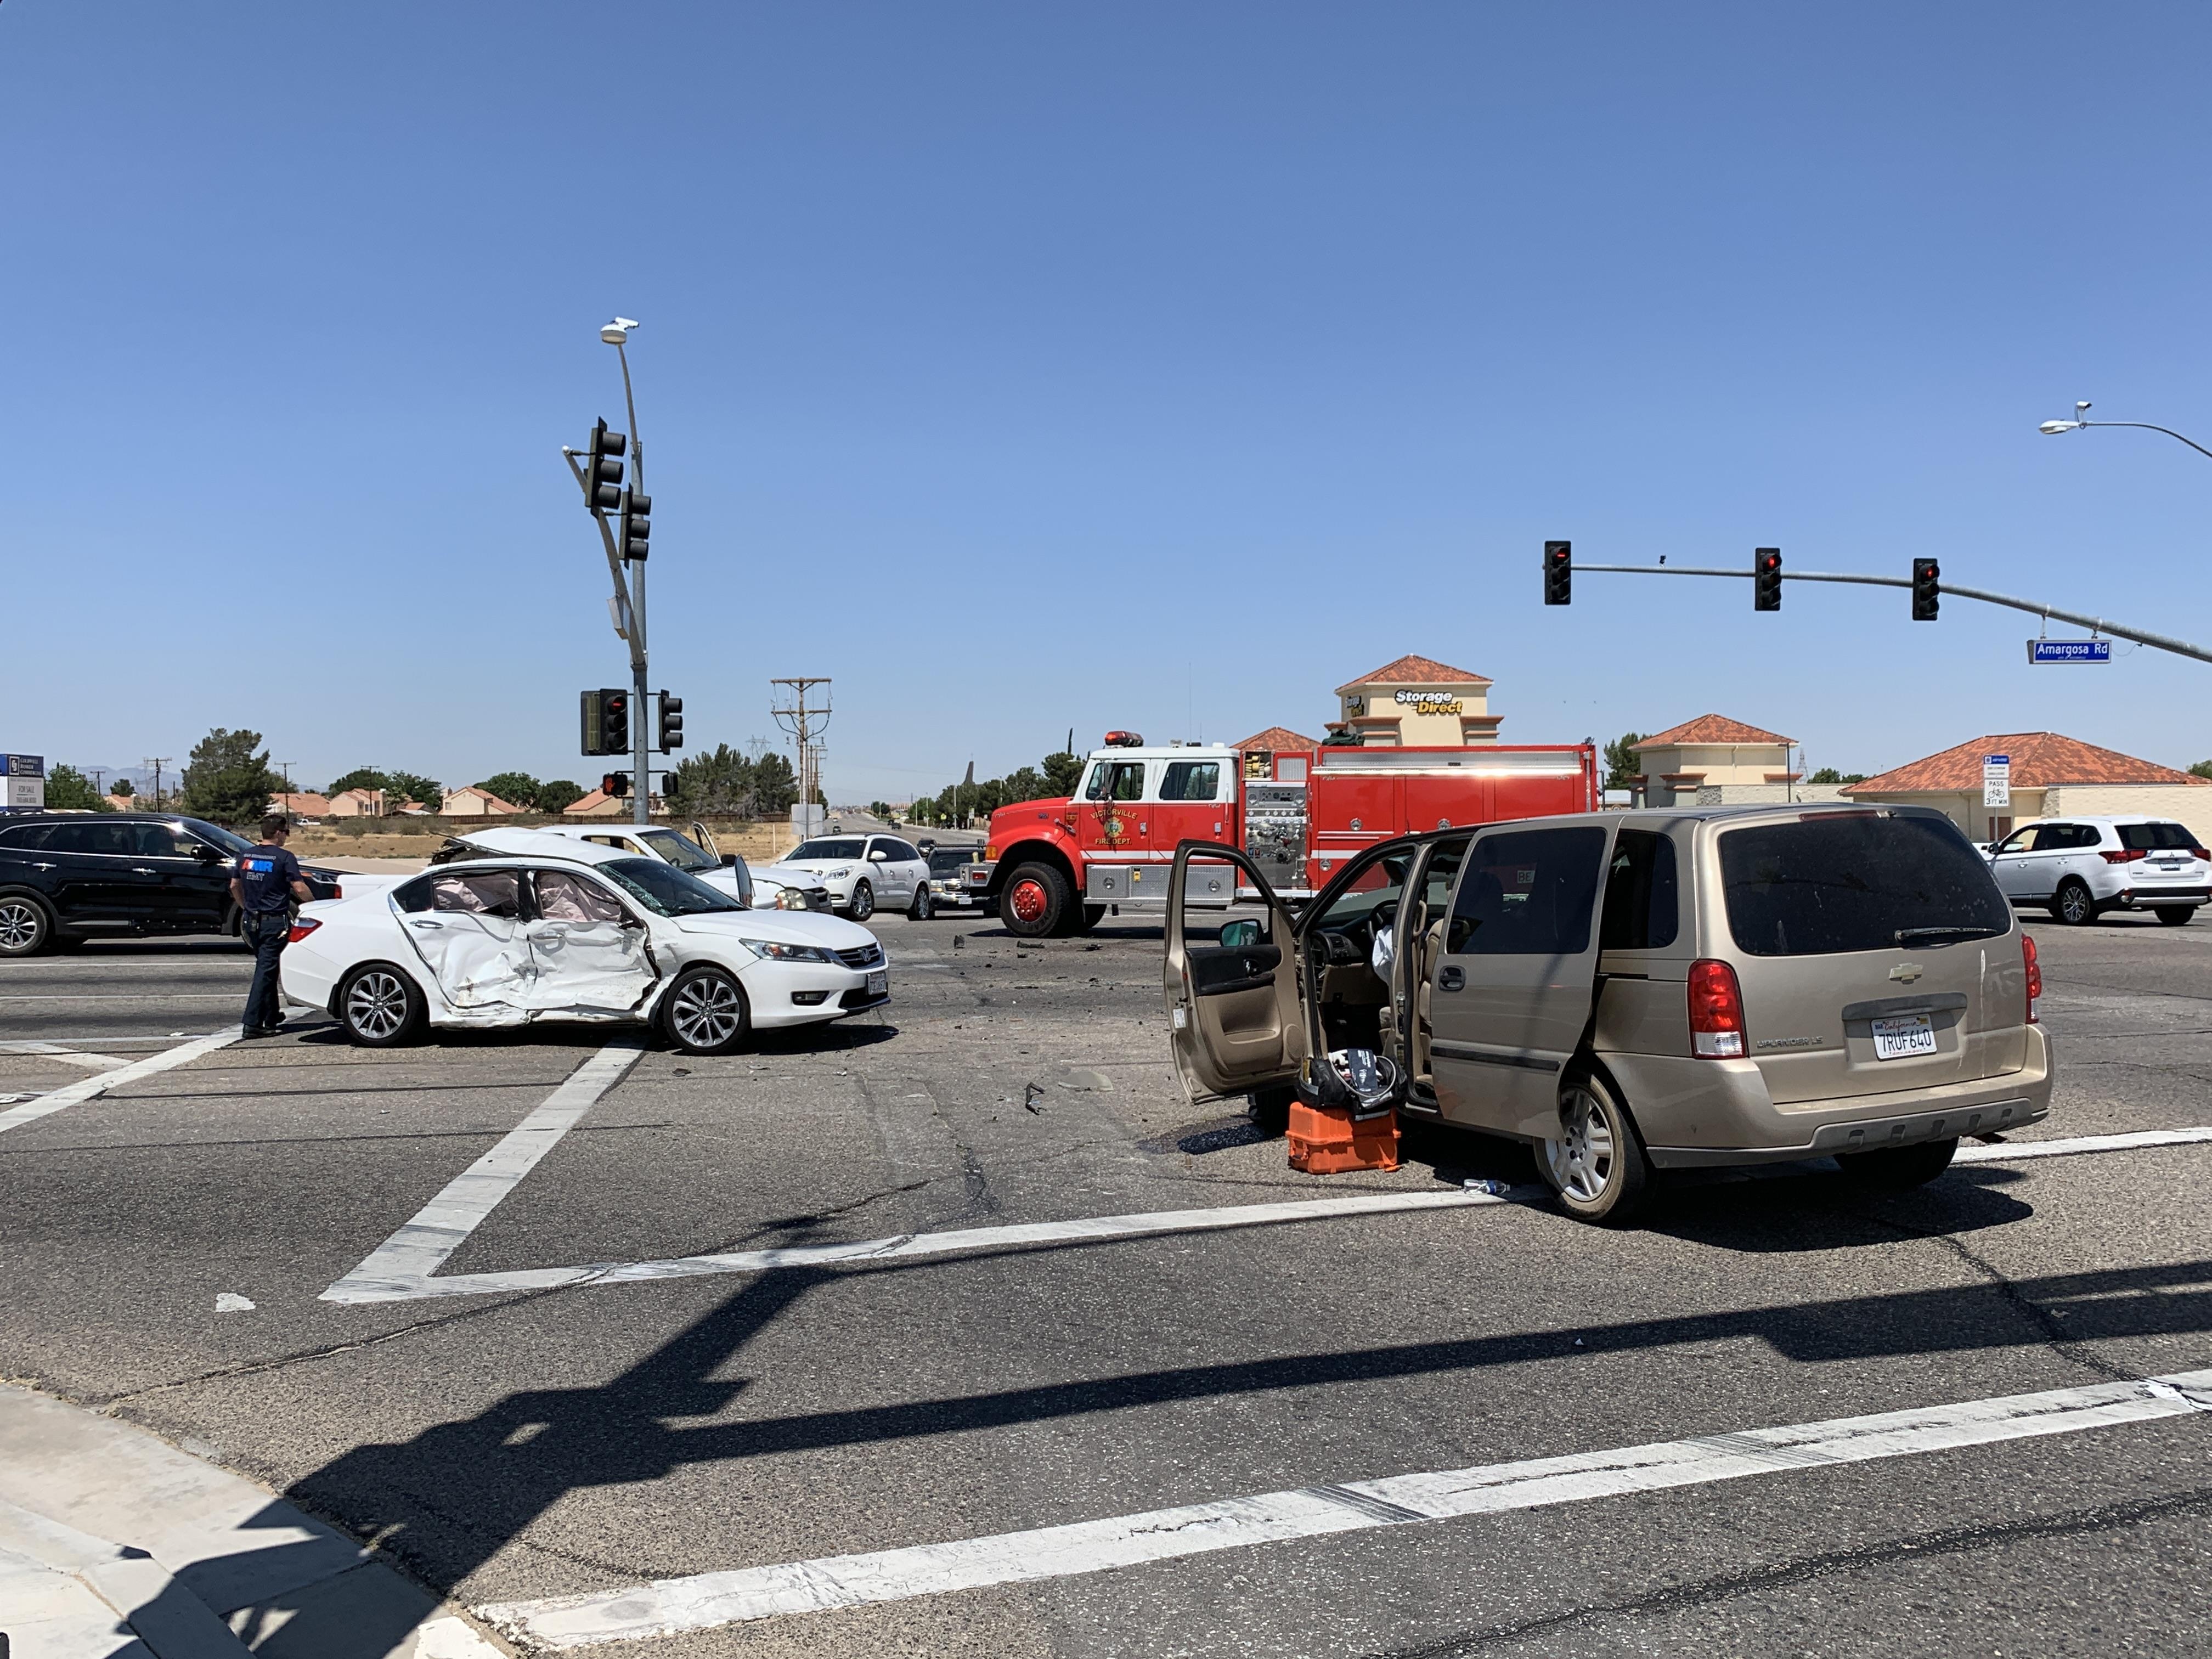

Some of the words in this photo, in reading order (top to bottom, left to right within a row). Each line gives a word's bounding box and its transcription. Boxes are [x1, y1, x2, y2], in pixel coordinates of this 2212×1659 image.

[2037, 644, 2089, 657] Amargosa
[2095, 643, 2108, 654] Rd
[1395, 690, 1453, 703] Storage
[1417, 702, 1463, 713] Direct
[1090, 809, 1137, 820] VICTORVILLE
[241, 859, 273, 872] AMR
[246, 871, 265, 881] EMT
[1884, 1019, 1920, 1031] California
[1878, 1029, 1932, 1052] 7RUF640
